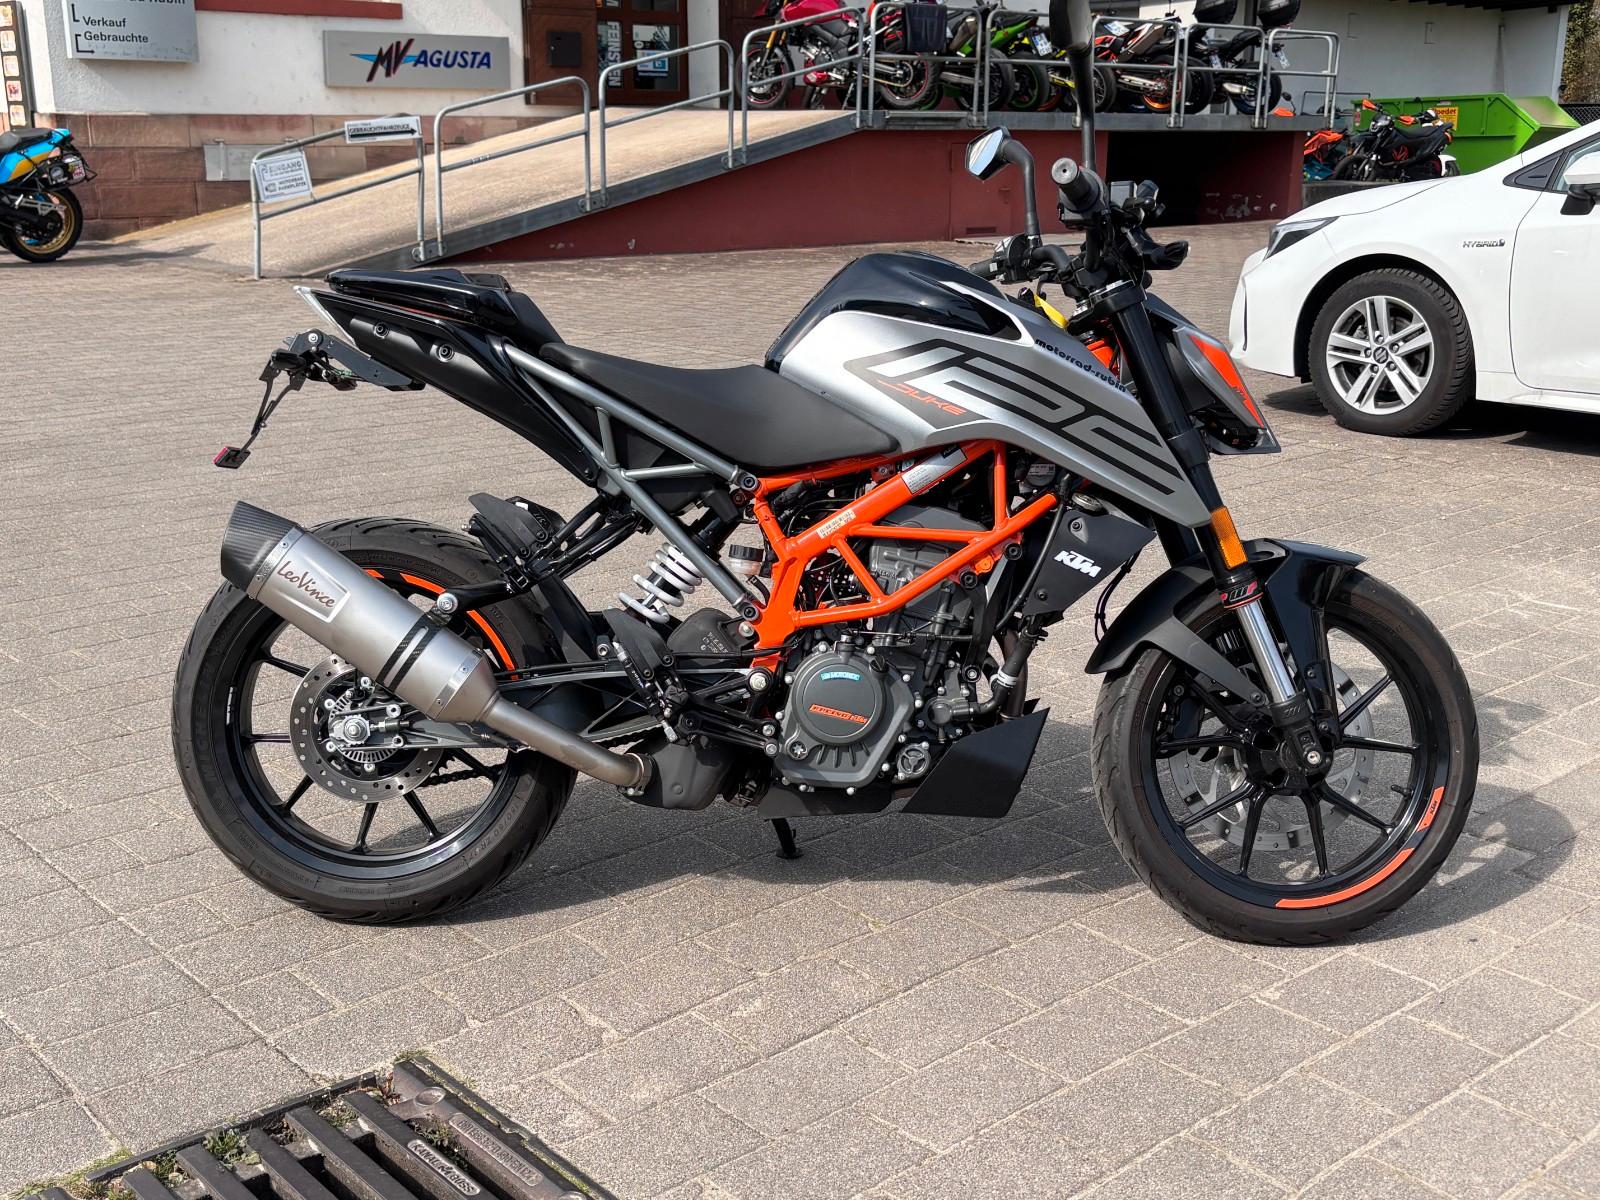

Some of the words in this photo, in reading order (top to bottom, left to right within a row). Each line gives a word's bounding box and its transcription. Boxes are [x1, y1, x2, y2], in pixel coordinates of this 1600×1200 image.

[83, 16, 126, 28] Verkauf
[84, 31, 149, 43] Gebrauchte
[366, 38, 415, 82] MV
[413, 49, 491, 69] AGUSTA
[1463, 240, 1499, 248] HYBRID
[1035, 338, 1127, 393] motorrad-rubin
[878, 379, 967, 415] DUKE
[1054, 550, 1102, 578] KTM
[277, 560, 335, 608] LeoVince
[411, 1143, 440, 1166] KANAL
